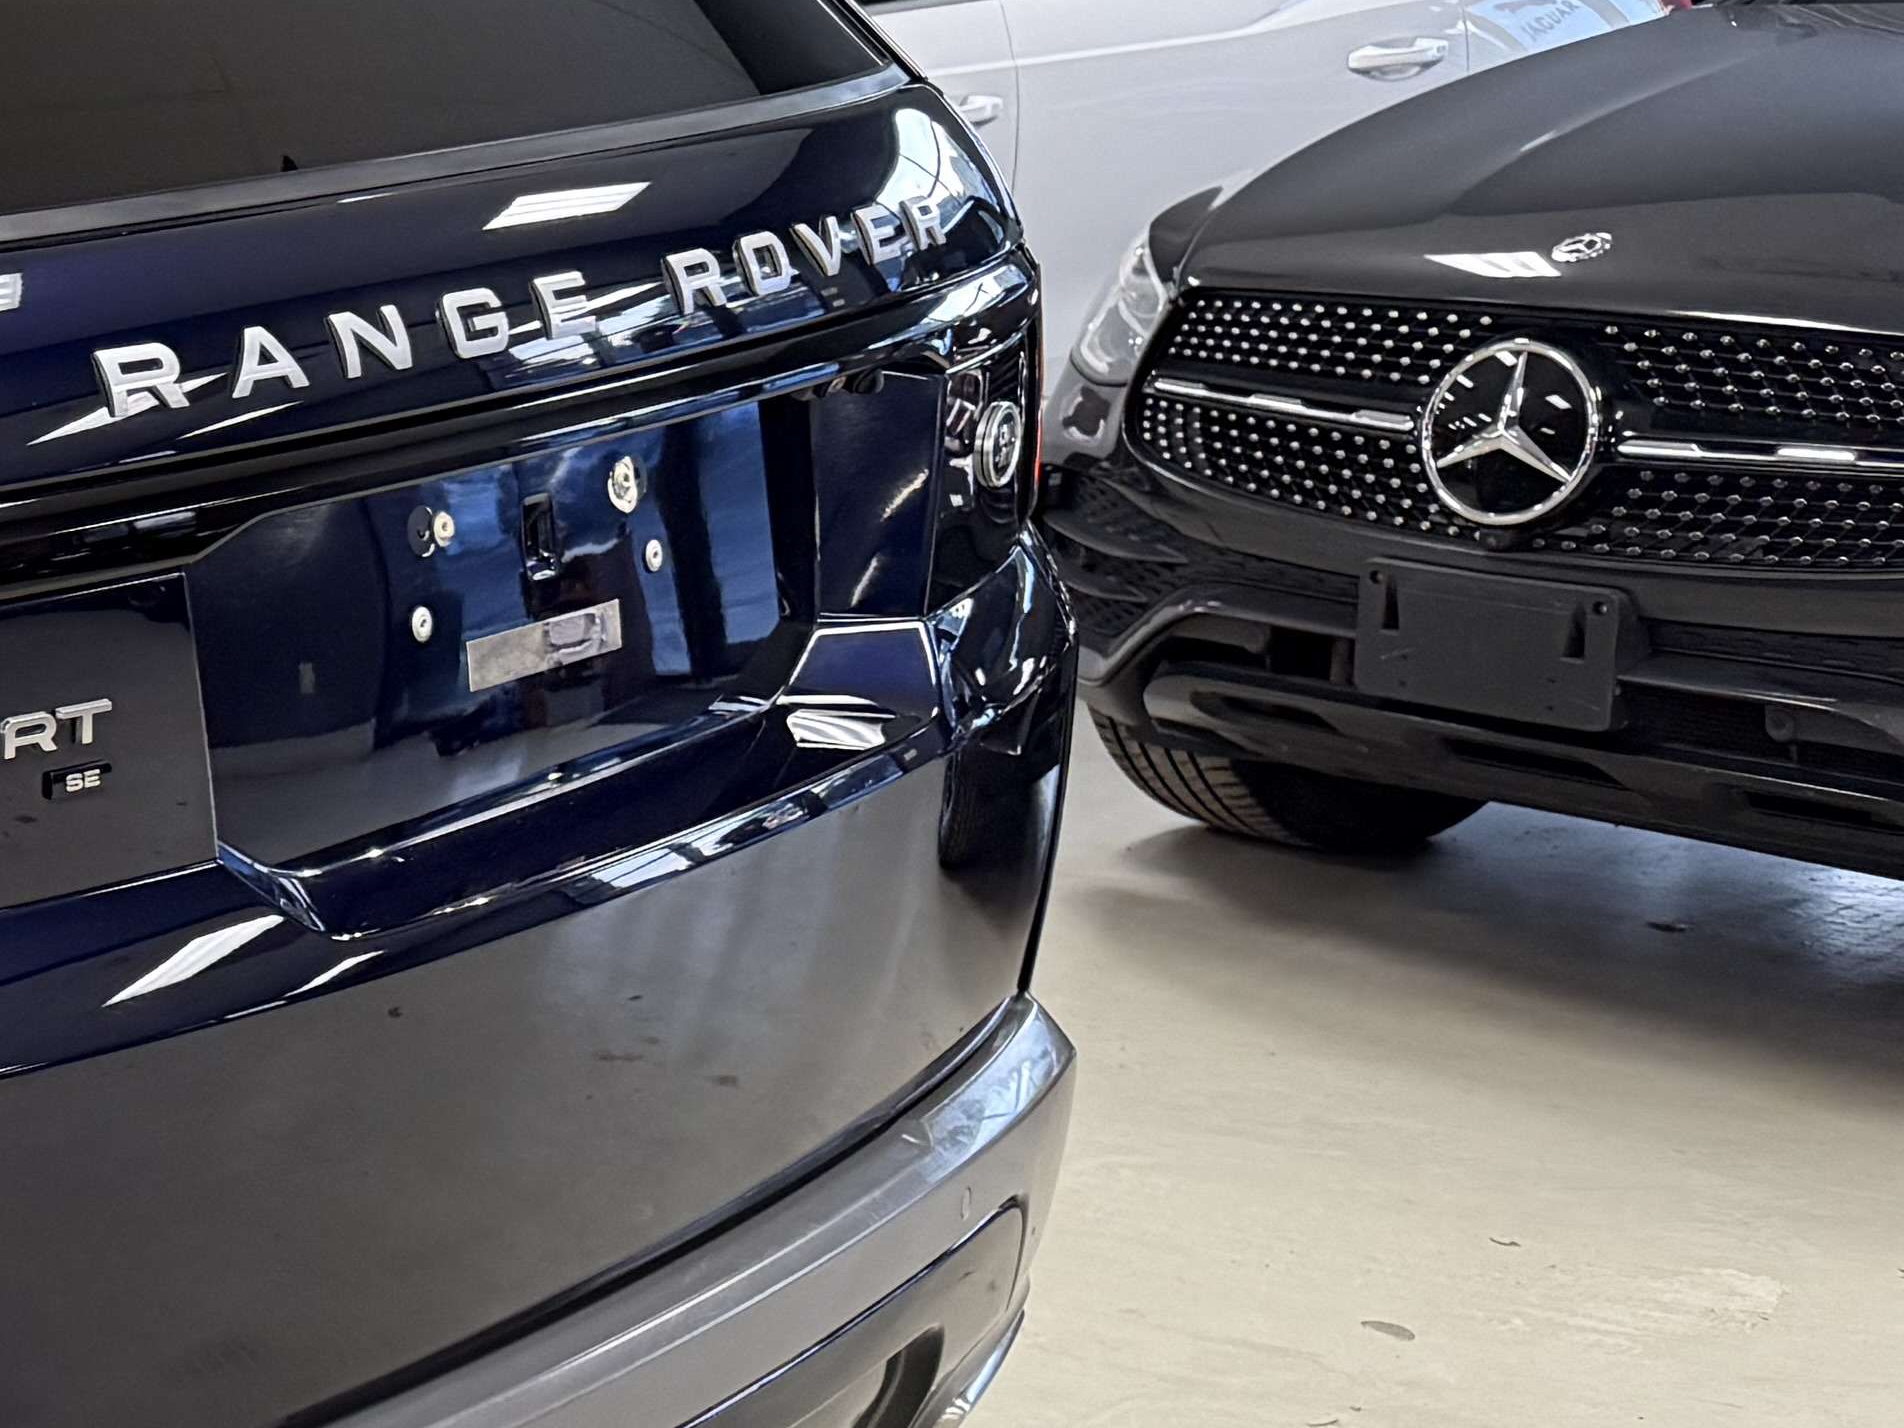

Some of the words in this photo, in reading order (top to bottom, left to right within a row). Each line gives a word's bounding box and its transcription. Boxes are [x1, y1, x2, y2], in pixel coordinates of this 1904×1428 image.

[1521, 0, 1581, 42] JAGUAR
[92, 270, 598, 419] RANGE
[663, 195, 948, 316] ROVER
[65, 769, 101, 793] SE
